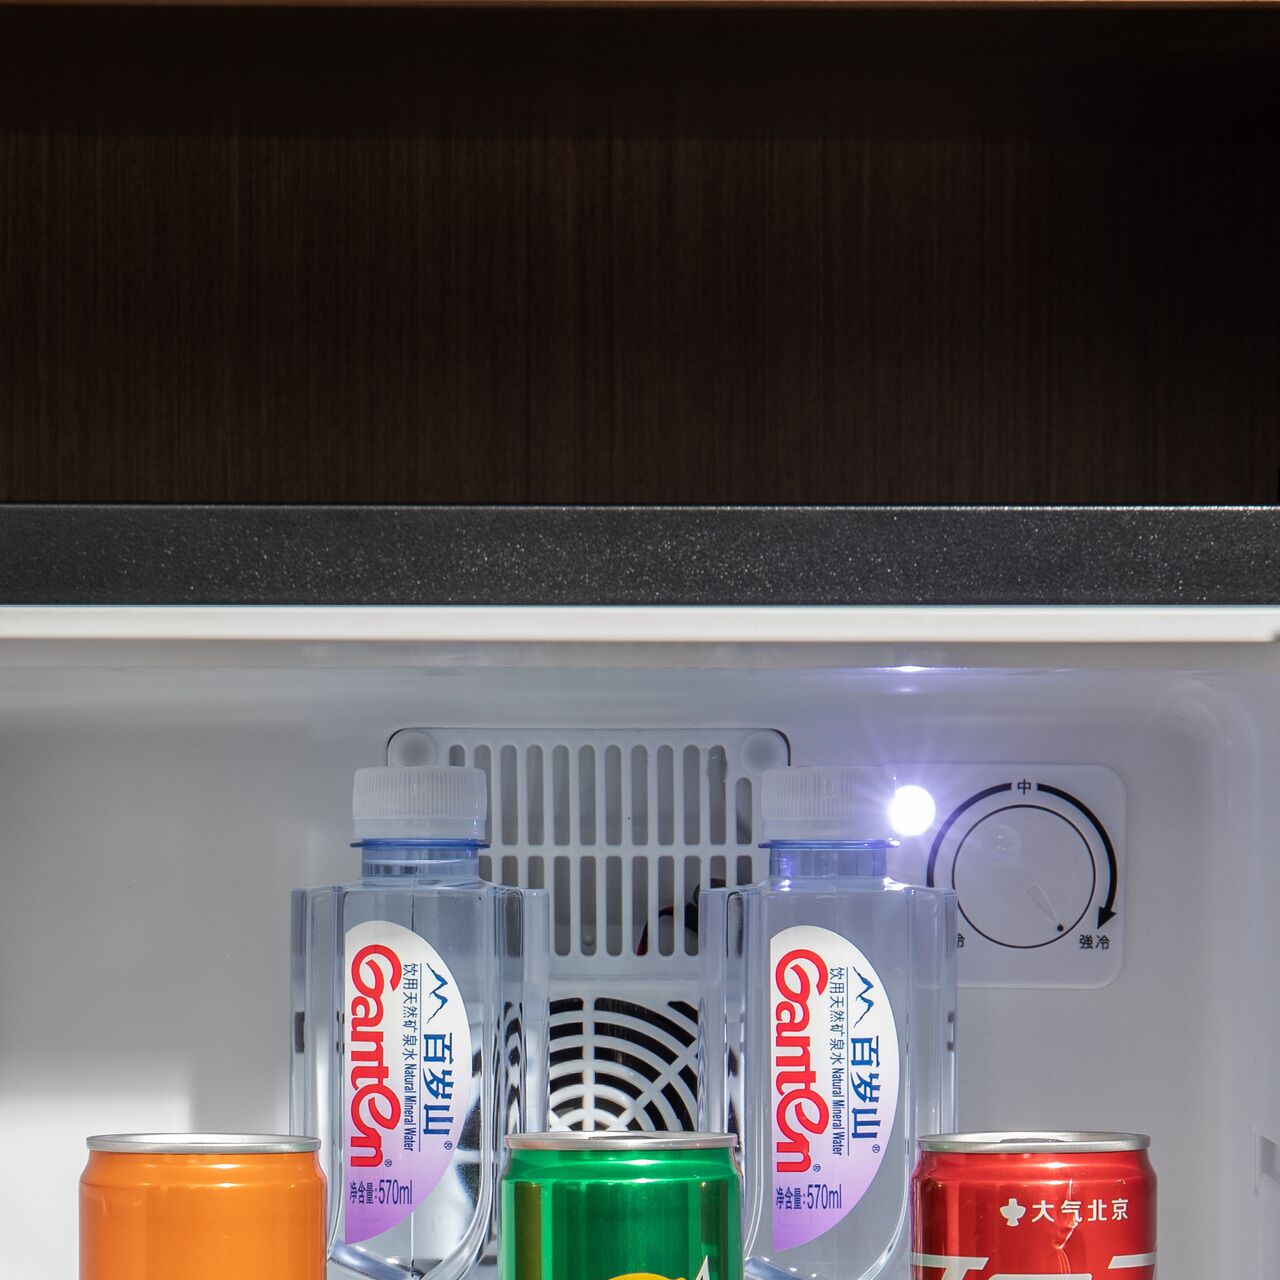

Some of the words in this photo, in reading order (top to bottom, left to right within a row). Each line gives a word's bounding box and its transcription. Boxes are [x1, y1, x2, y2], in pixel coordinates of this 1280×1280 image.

[1017, 779, 1032, 795] 中
[402, 963, 418, 1061] 饮用天然矿泉水
[829, 966, 845, 1065] 饮用天然矿泉水
[404, 1064, 417, 1093] Natural
[423, 1032, 454, 1135] 百岁山
[832, 1067, 845, 1097] Natural
[850, 1035, 881, 1139] 百岁山
[404, 1095, 417, 1125] Mineral
[832, 1099, 845, 1129] Mineral
[404, 1128, 417, 1151] Water
[832, 1131, 845, 1155] Water
[1032, 1198, 1129, 1223] 大气北京
